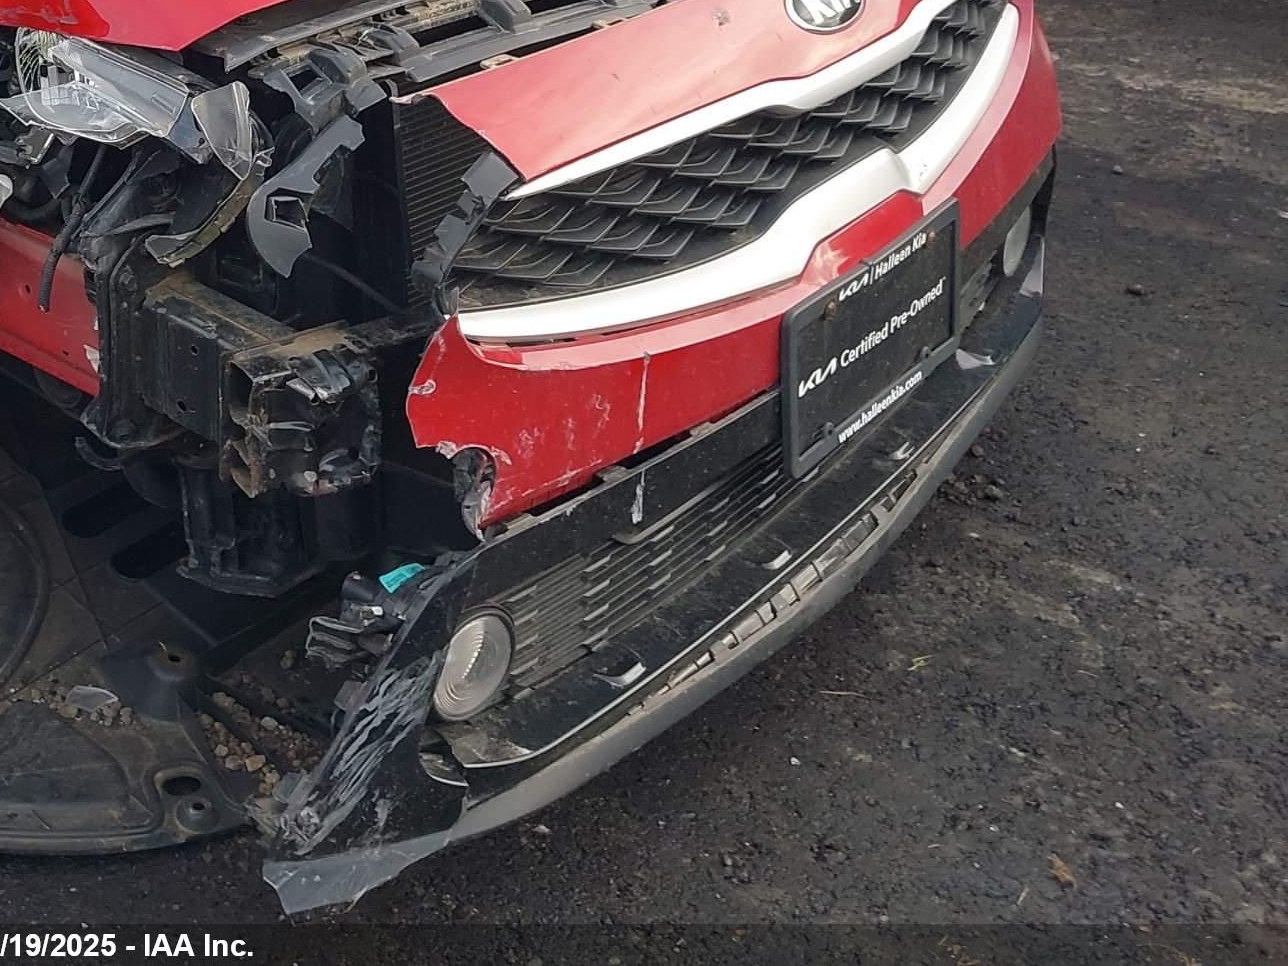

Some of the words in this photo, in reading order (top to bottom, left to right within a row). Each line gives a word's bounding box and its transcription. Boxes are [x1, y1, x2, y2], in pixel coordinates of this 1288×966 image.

[874, 245, 911, 280] Halleen
[912, 232, 927, 252] Kia
[840, 322, 889, 367] Certified
[838, 371, 922, 444] www.halleenkia.com
